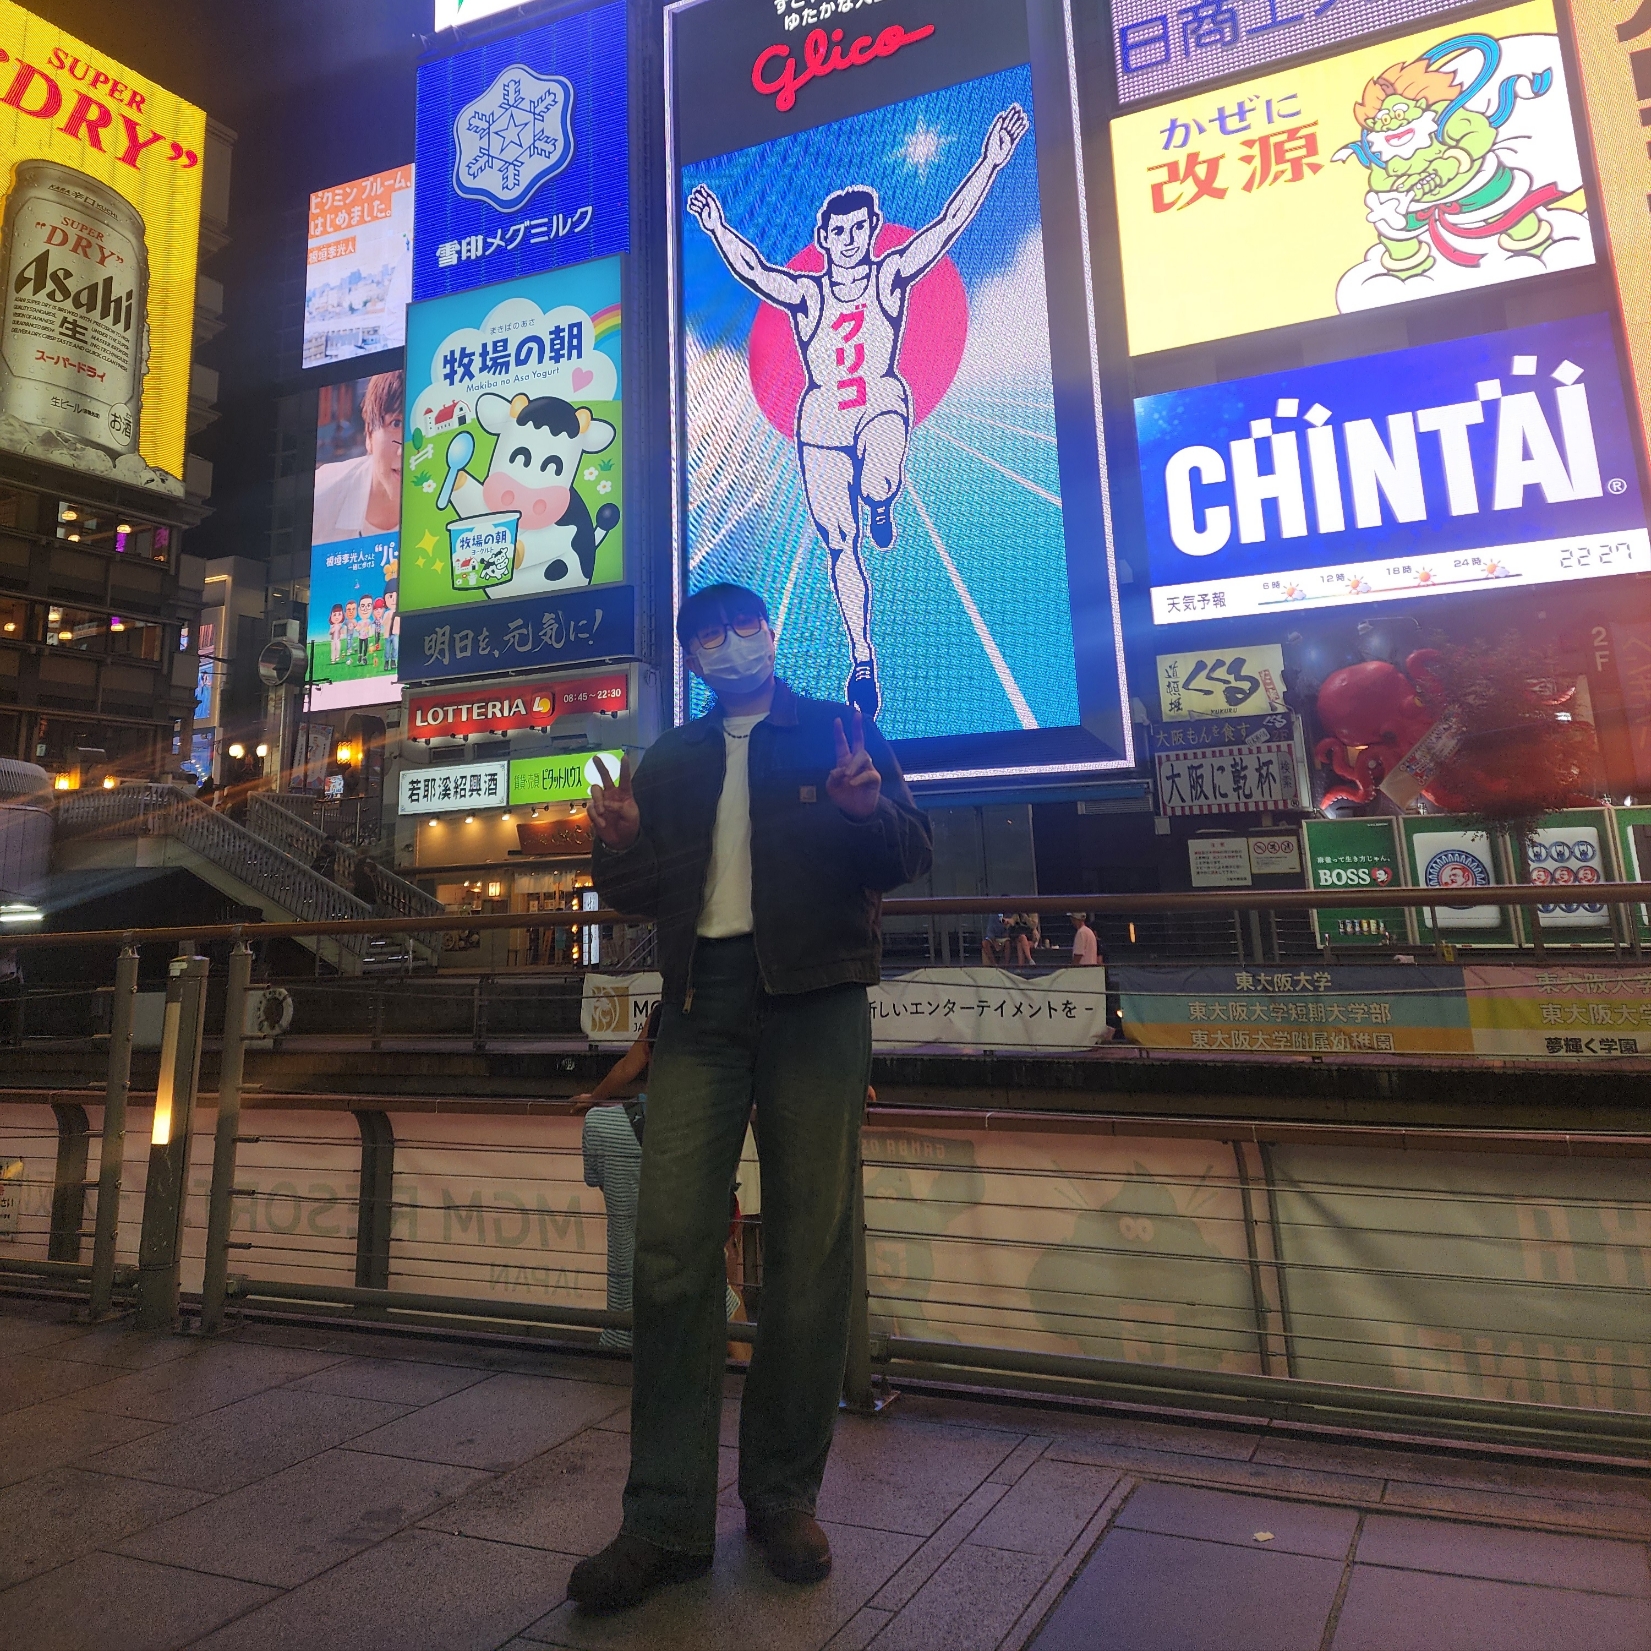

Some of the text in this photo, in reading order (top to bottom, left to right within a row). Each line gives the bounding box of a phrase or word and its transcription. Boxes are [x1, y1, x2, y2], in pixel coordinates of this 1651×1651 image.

[47, 47, 146, 114] SUPER
[751, 24, 935, 112] Glico
[1159, 91, 1303, 151] かぜに
[1146, 119, 1326, 214] 改源
[311, 187, 357, 213] ピクミン
[61, 216, 105, 243] SUPER
[310, 200, 391, 236] はじめました。
[436, 205, 593, 269] 雪印メグミルク
[14, 249, 133, 333] Asahi
[59, 315, 88, 345] 生
[490, 318, 536, 335] まきばのあさ
[35, 349, 106, 383] スーパードライ
[443, 321, 584, 387] 牧場の朝
[831, 302, 867, 411] グリコ
[466, 367, 561, 393] Makiba no Asa Yogurt
[50, 396, 82, 414] 生ビール
[1164, 356, 1604, 557] CHINTAI
[459, 530, 507, 550] 牧場の朝
[1560, 543, 1633, 569] 22 27
[1166, 556, 1483, 615] 天気予報 6時 12時 18時 24時
[1165, 661, 1184, 713] 道頓堀
[1182, 657, 1261, 707] くくる
[415, 697, 527, 728] LOTTERIA
[1210, 707, 1238, 715] KUKURU
[1156, 722, 1251, 747] 大阪もんを食す
[542, 766, 583, 790] ピタットハウス
[1166, 756, 1293, 804] 大阪に乾杯 検索
[1318, 868, 1371, 886] BOSS
[1234, 971, 1332, 992] 東大阪大学
[1188, 1001, 1392, 1025] 東大阪大学短期大学部
[1190, 1029, 1395, 1052] 東大阪大学附属幼稚園
[1545, 1037, 1639, 1055] 夢輝く学園
